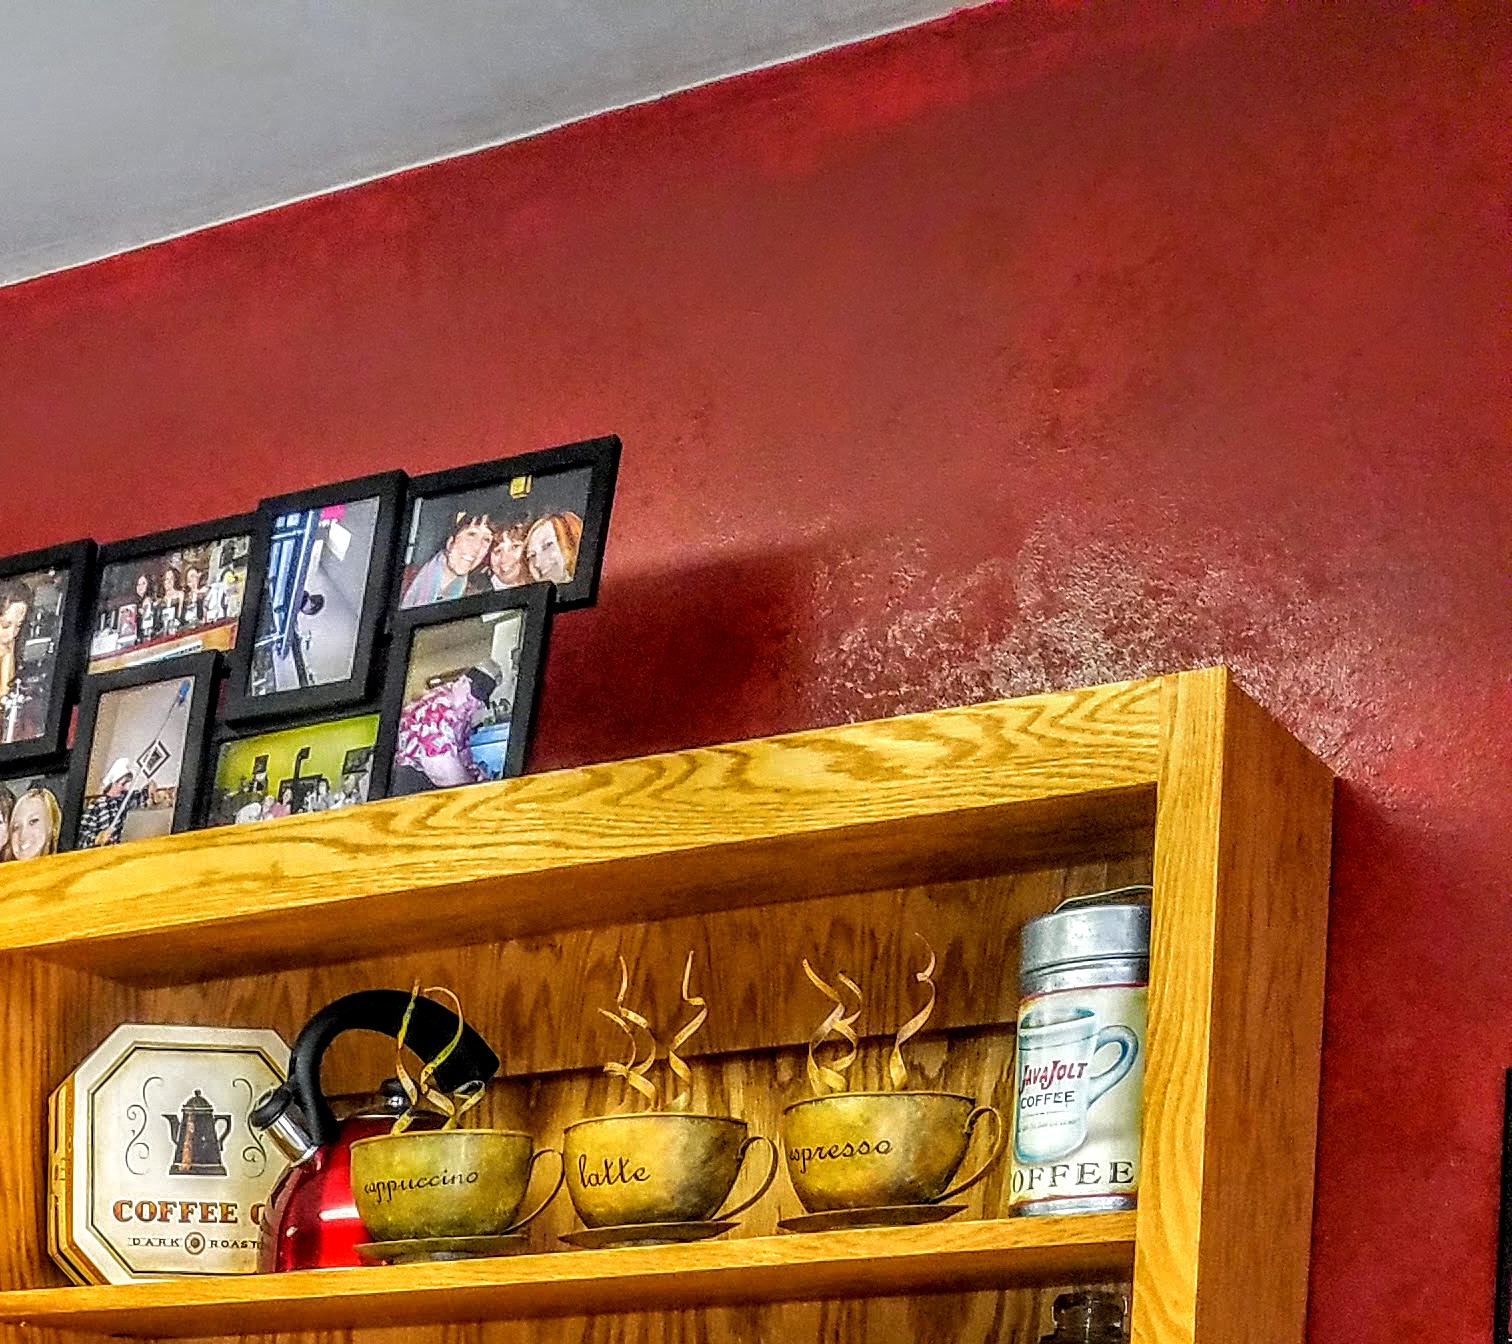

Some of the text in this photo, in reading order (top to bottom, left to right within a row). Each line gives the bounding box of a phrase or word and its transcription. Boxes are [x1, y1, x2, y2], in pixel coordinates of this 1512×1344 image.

[1021, 1091, 1076, 1109] COFFEE
[578, 1153, 651, 1188] latte
[112, 1199, 238, 1224] COFFEE
[132, 1237, 261, 1250] DARK ROAST
